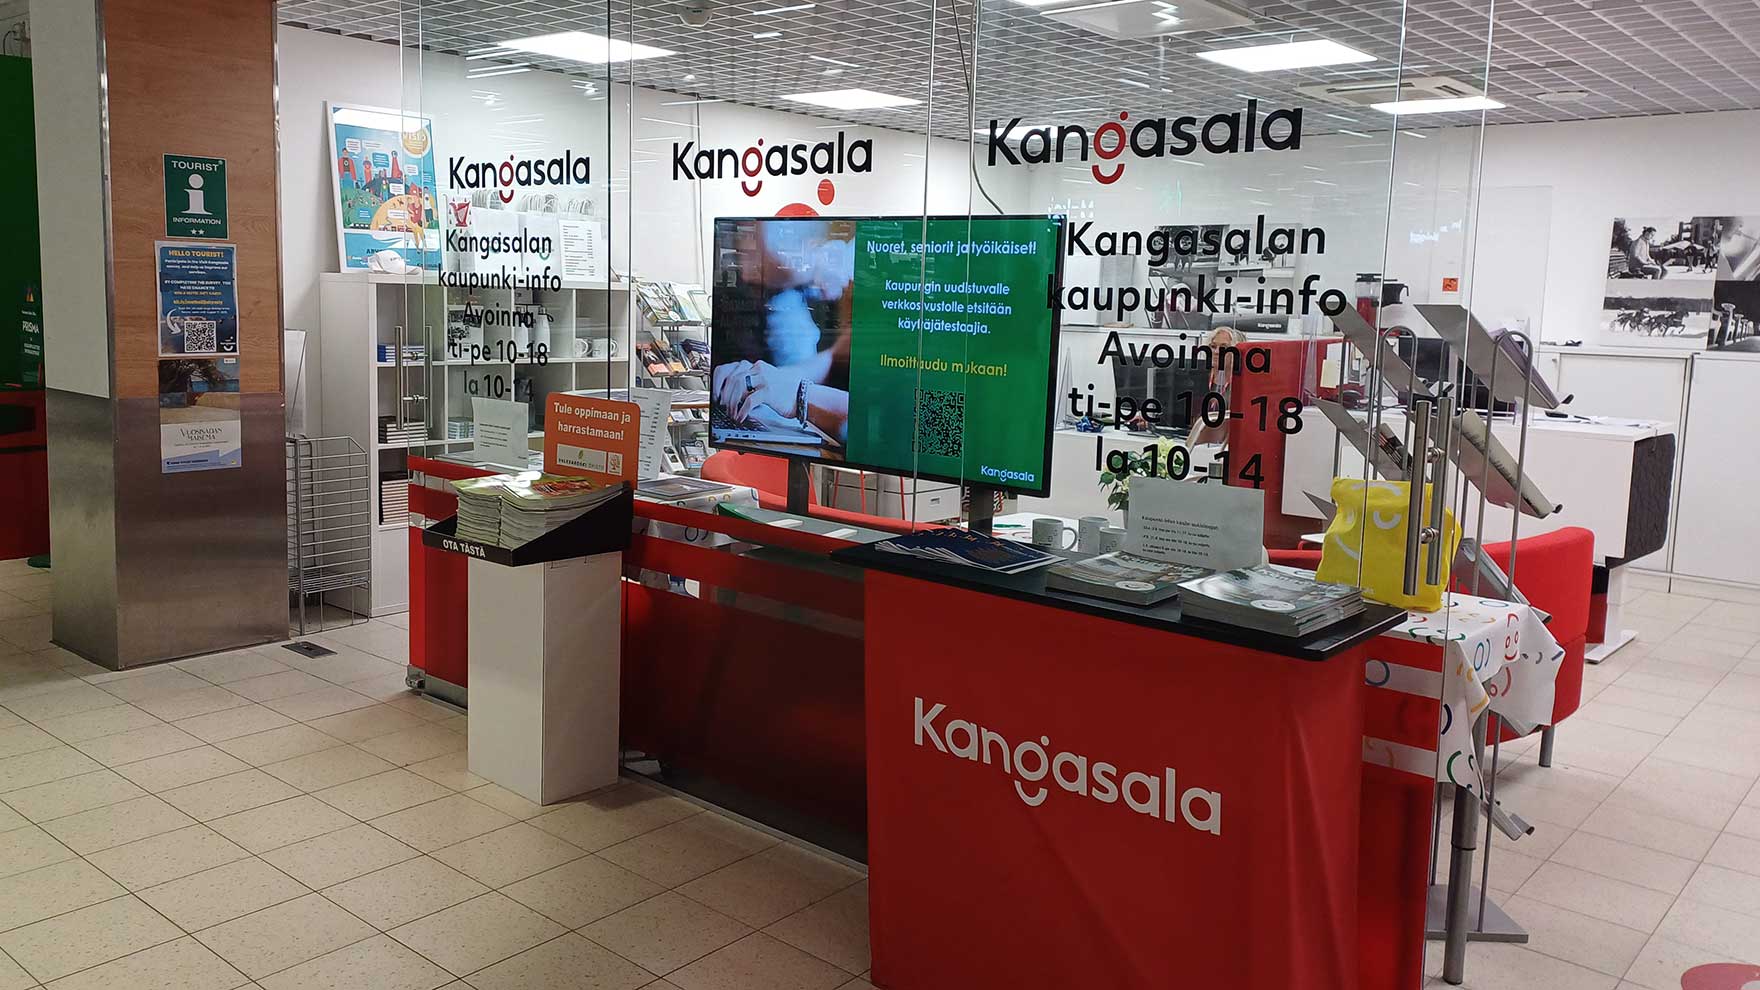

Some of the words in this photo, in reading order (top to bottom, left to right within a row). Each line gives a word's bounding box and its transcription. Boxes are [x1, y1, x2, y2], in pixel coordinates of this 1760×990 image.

[988, 99, 1302, 184] Kangasala
[449, 150, 590, 203] Kangasala
[672, 131, 872, 197] Kangasala
[172, 217, 222, 225] INFORMATION
[446, 228, 552, 260] Kangasalan
[866, 240, 907, 254] Nuoret,
[911, 240, 954, 253] seniorit
[956, 241, 969, 256] ja
[971, 241, 1037, 256] työikäiset!
[1068, 215, 1326, 266] Kangasalan
[438, 263, 562, 294] kaupunki-info
[885, 279, 940, 295] Kaupungin
[944, 281, 1010, 295] uudistuvalle
[882, 299, 965, 313] verkkosvustolle
[967, 302, 1012, 315] etsitään
[1047, 274, 1347, 321] kaupunki-info
[22, 320, 40, 334] PRISMA
[463, 301, 534, 328] Avoinna
[450, 340, 491, 366] ti-pe
[497, 340, 548, 366] 10-18
[880, 354, 948, 372] Ilmoittaudu
[1097, 331, 1271, 373] Avoinna
[464, 370, 478, 395] la
[554, 402, 572, 414] Tule
[574, 407, 619, 420] oppimaan
[620, 411, 631, 425] ja
[1068, 384, 1161, 430] ti-pe
[1177, 391, 1303, 435] 10-18
[558, 421, 624, 441] harrastamaan!
[980, 465, 1035, 483] Kangasala
[1096, 436, 1129, 474] la
[1143, 443, 1264, 489] 10-14
[443, 539, 458, 552] OTA
[459, 542, 486, 558] TÄSTÄ
[914, 697, 1221, 835] Kangasala
